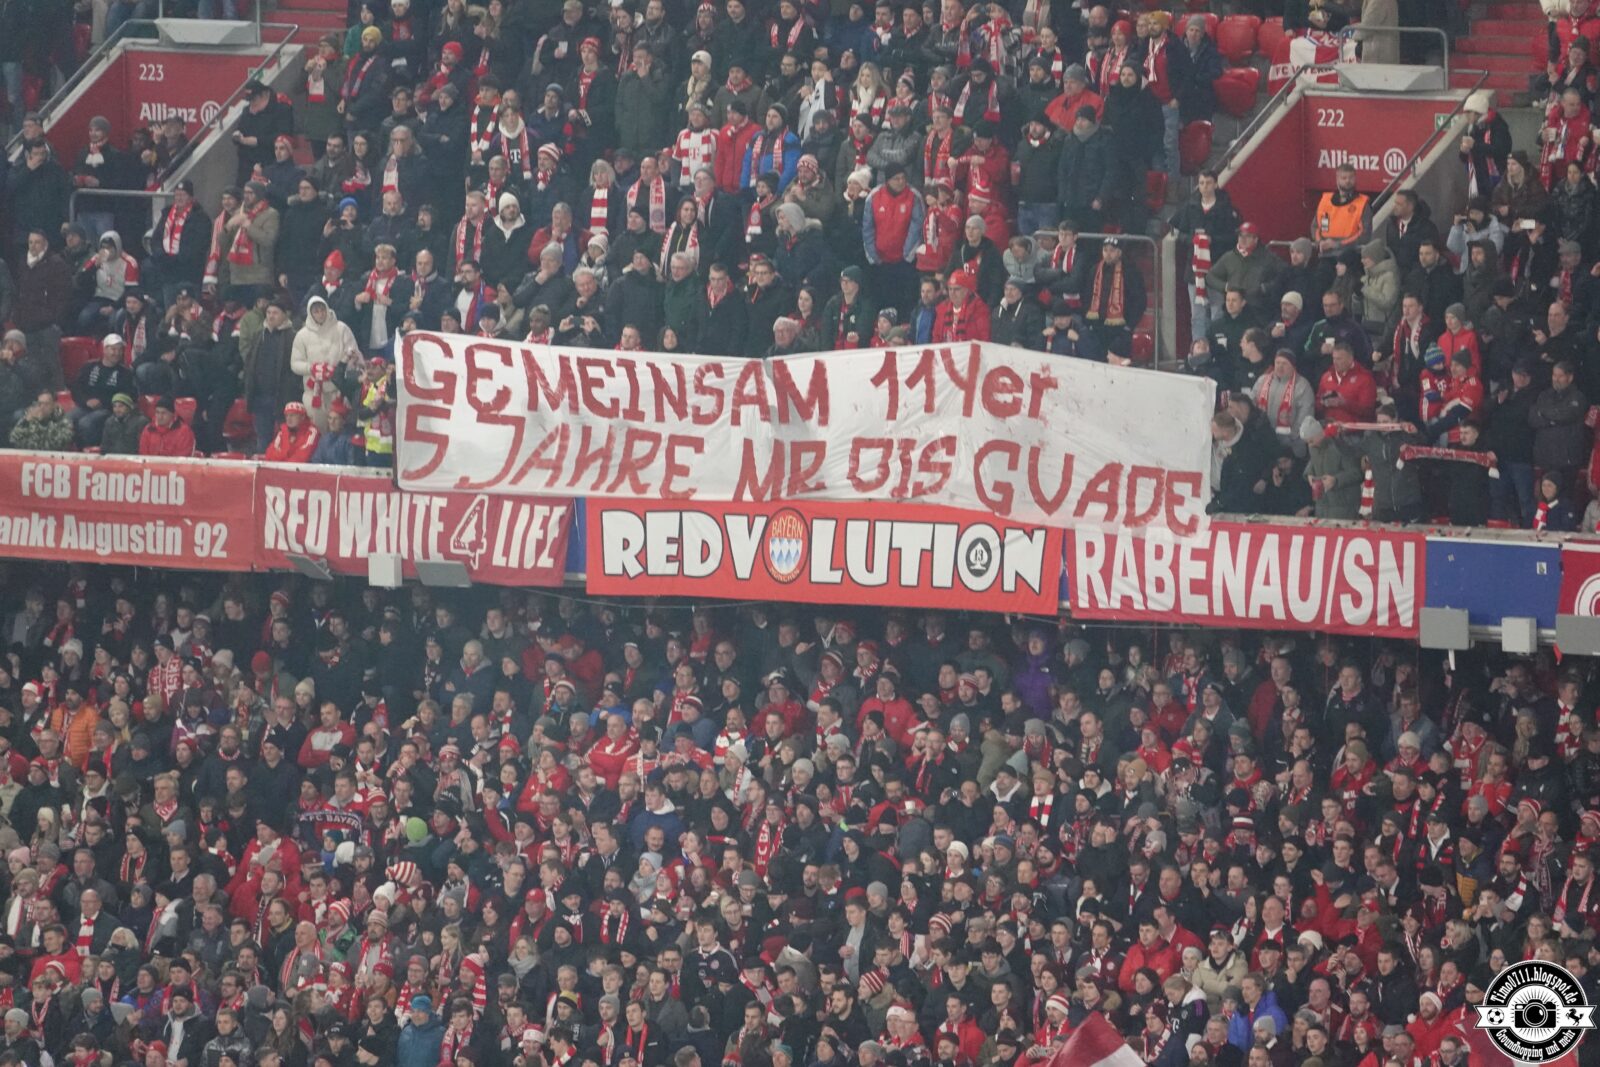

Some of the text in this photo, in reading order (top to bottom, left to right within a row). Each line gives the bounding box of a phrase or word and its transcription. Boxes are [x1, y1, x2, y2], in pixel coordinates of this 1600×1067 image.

[139, 63, 164, 81] 223
[139, 102, 197, 122] Allianz
[1318, 108, 1344, 128] 222
[1318, 149, 1380, 170] Allianz
[401, 333, 830, 427] GEMEINSAM
[401, 404, 452, 482] 5
[453, 411, 704, 499] JAHRE
[22, 462, 185, 506] FCB Fanclub
[264, 485, 568, 570] RED WHITE 4 LIFE
[772, 514, 804, 538] BAYERN
[1074, 525, 1416, 628] RABENAU/SN
